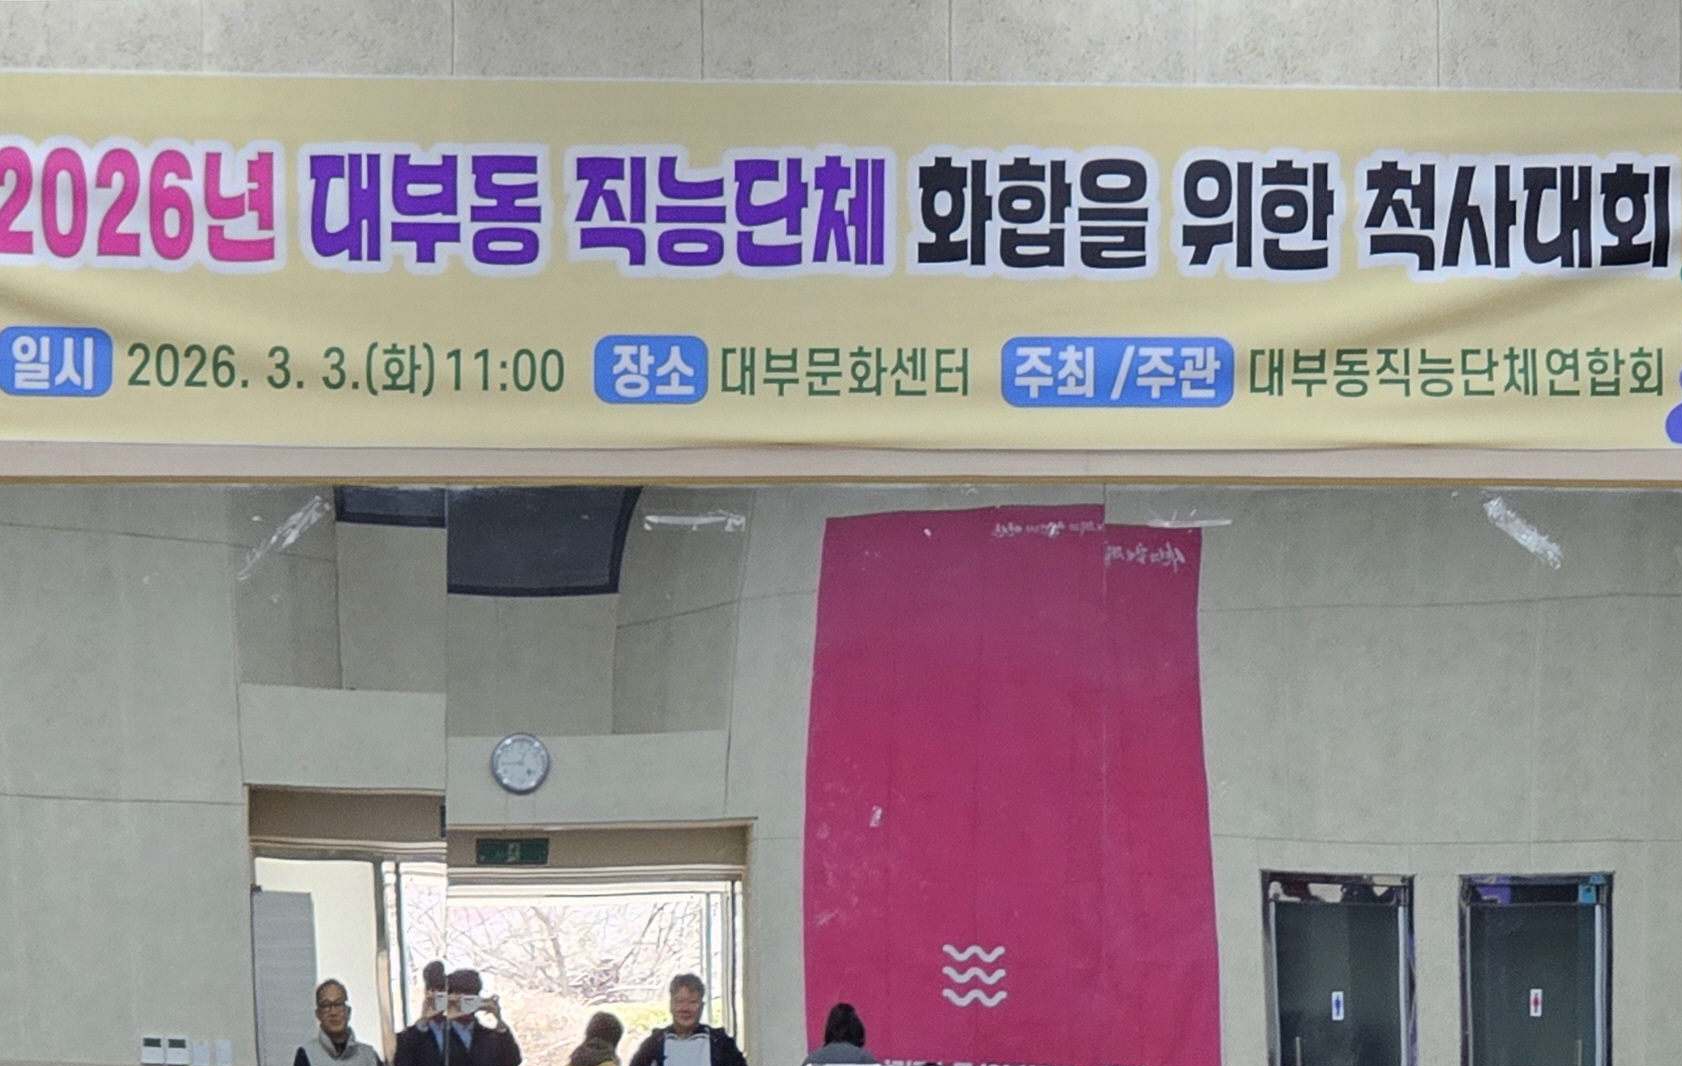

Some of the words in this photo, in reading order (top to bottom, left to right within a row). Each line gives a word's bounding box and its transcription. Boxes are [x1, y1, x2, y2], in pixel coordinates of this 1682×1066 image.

[0, 147, 275, 262] 2026년
[309, 153, 542, 265] 대부동
[575, 155, 886, 267] 직능단체
[917, 156, 1149, 269] 화합을
[1182, 159, 1335, 270] 위한
[1364, 161, 1671, 271] 척사대회
[11, 335, 95, 391] 일시
[127, 342, 250, 388] 2026.
[266, 346, 304, 390] 3.
[612, 344, 696, 398] 장소
[720, 345, 970, 397] 대부문화센터
[1013, 345, 1096, 399] 주최
[1249, 346, 1665, 397] 대부동직능단체연합회
